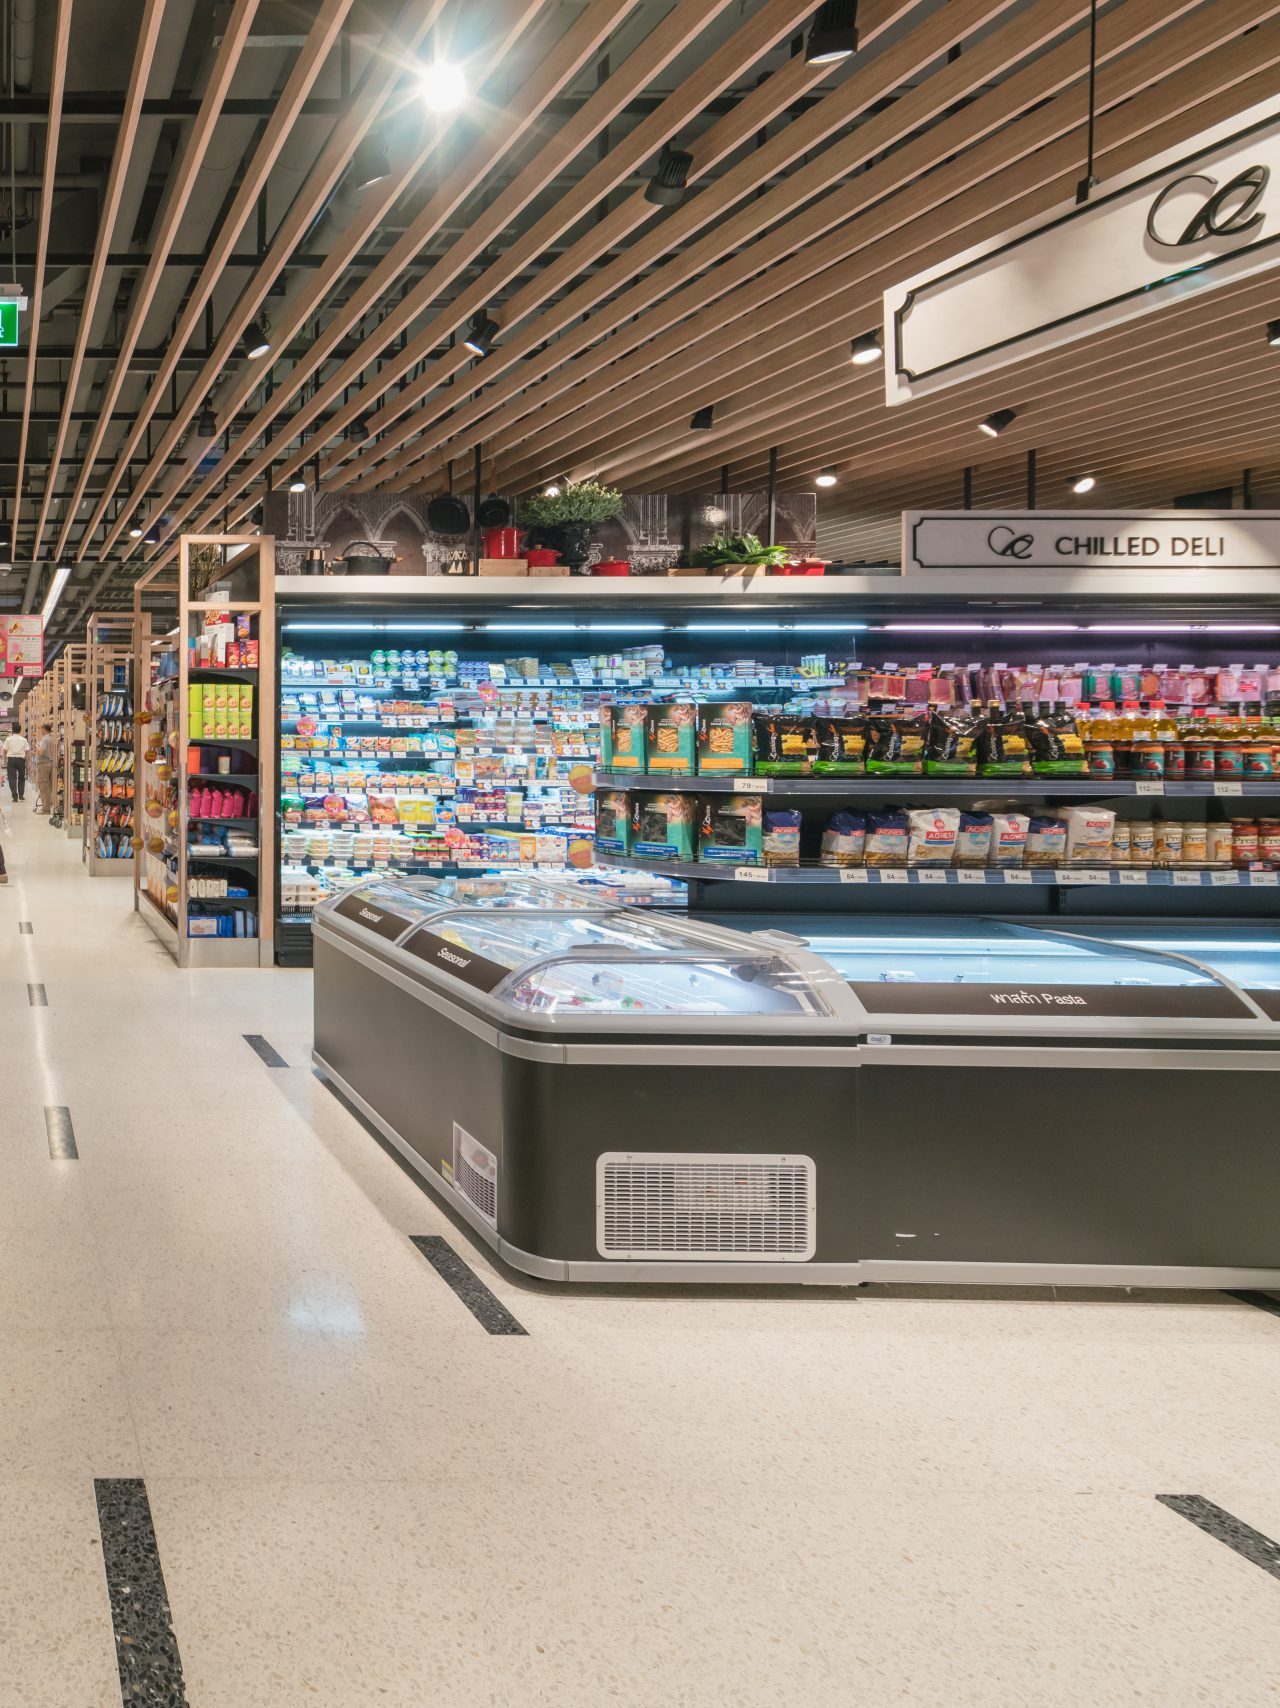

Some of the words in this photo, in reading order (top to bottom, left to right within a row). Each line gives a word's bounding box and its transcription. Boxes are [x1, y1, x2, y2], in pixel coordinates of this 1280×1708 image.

[1055, 536, 1160, 557] CHILLED
[1171, 536, 1225, 557] DELI
[928, 832, 955, 840] AGNESI
[359, 907, 384, 923] Seasonal
[437, 947, 472, 968] Seasonal
[989, 990, 1042, 1005] พาสต้า
[1041, 993, 1088, 1005] Pasta
